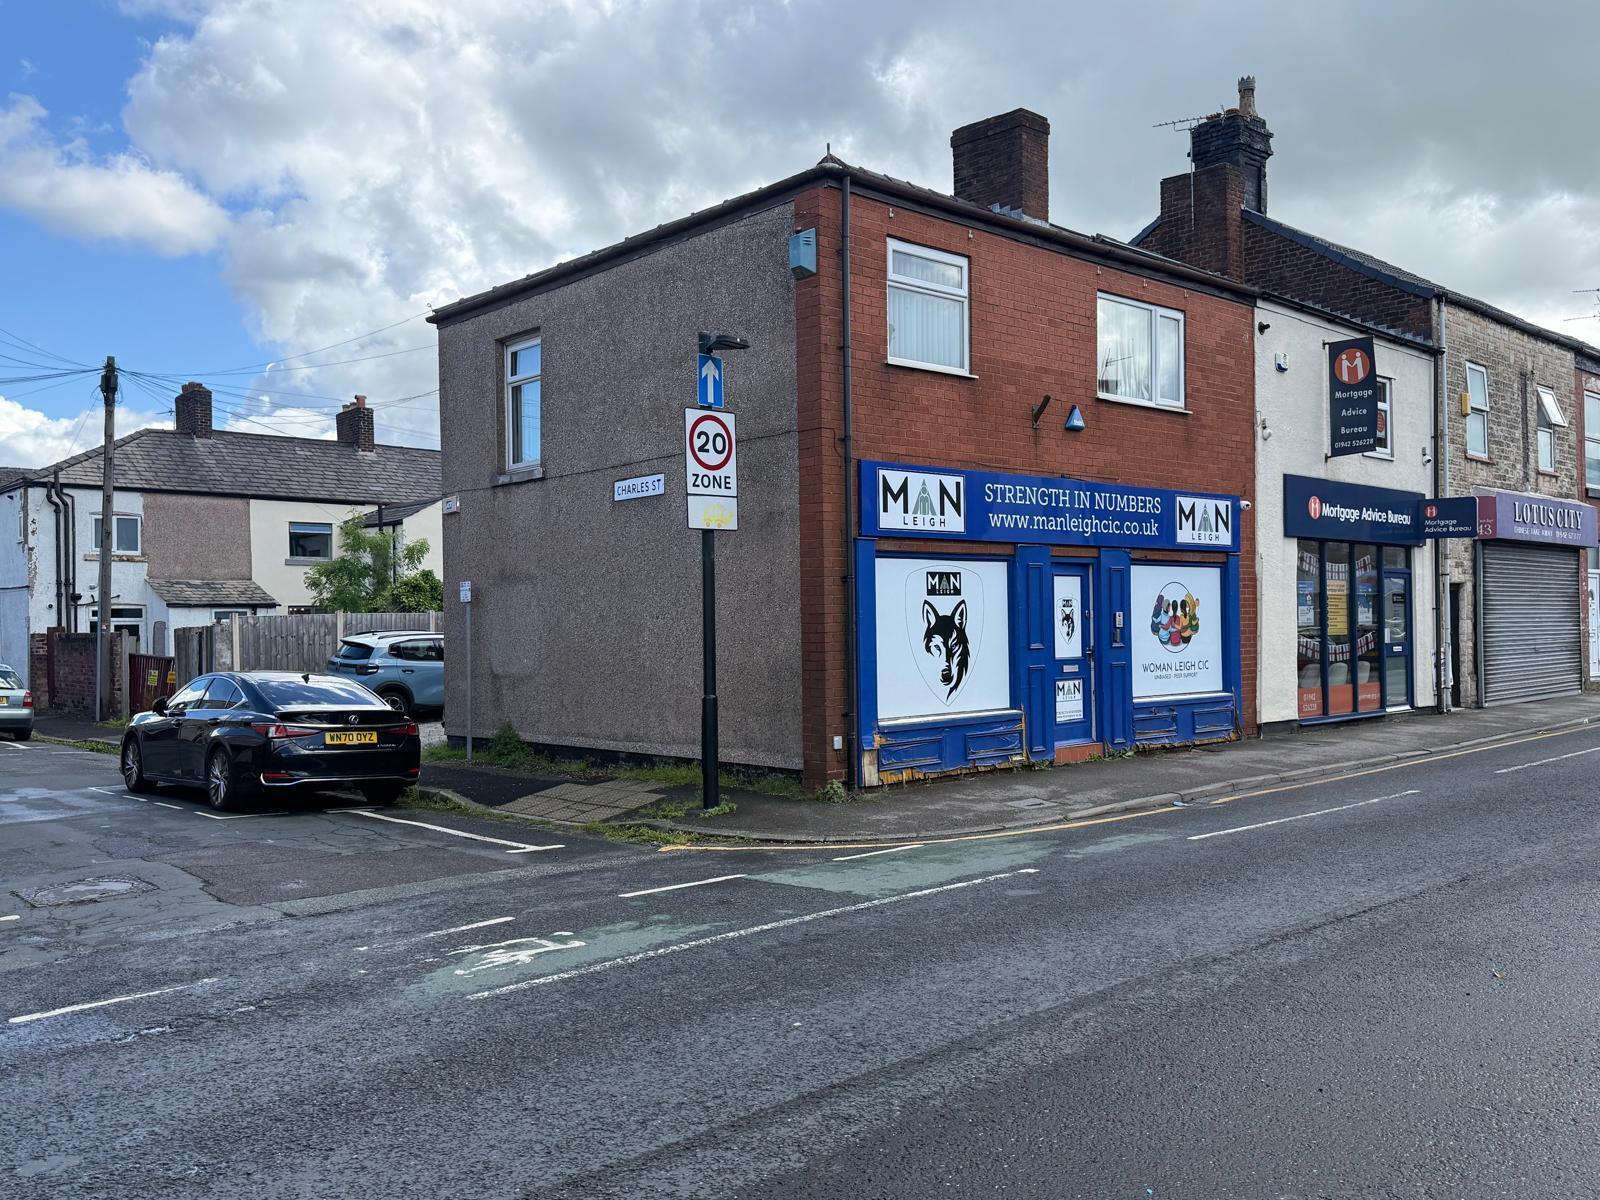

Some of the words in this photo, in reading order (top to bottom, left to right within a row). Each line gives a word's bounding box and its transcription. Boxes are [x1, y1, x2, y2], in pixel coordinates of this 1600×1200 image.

[1335, 389, 1373, 399] Mortgage
[1341, 407, 1367, 416] Advice
[1341, 426, 1368, 434] Bureau
[697, 431, 727, 455] 20
[1334, 441, 1351, 449] 01942
[616, 481, 650, 496] CHARLES
[651, 479, 662, 491] ST
[692, 473, 732, 490] ZONE
[984, 483, 1070, 508] STRENGTH
[1074, 491, 1091, 509] IN
[1094, 492, 1162, 514] NUMBERS
[1322, 502, 1360, 522] Mortgage
[1361, 507, 1387, 522] Advice
[1388, 512, 1411, 526] Bureau
[1513, 501, 1555, 527] LOTUS
[1556, 508, 1583, 530] CITY
[903, 516, 946, 528] LEIGH
[988, 513, 1159, 537] www.manleighcic.co.uk
[1424, 519, 1458, 527] Mortgage
[1191, 533, 1220, 542] LEIGH
[1142, 662, 1173, 673] WOMAN
[1174, 660, 1196, 672] LEIGH
[1197, 659, 1209, 670] CIC
[329, 733, 354, 742] WN70
[356, 732, 374, 742] OYZ
